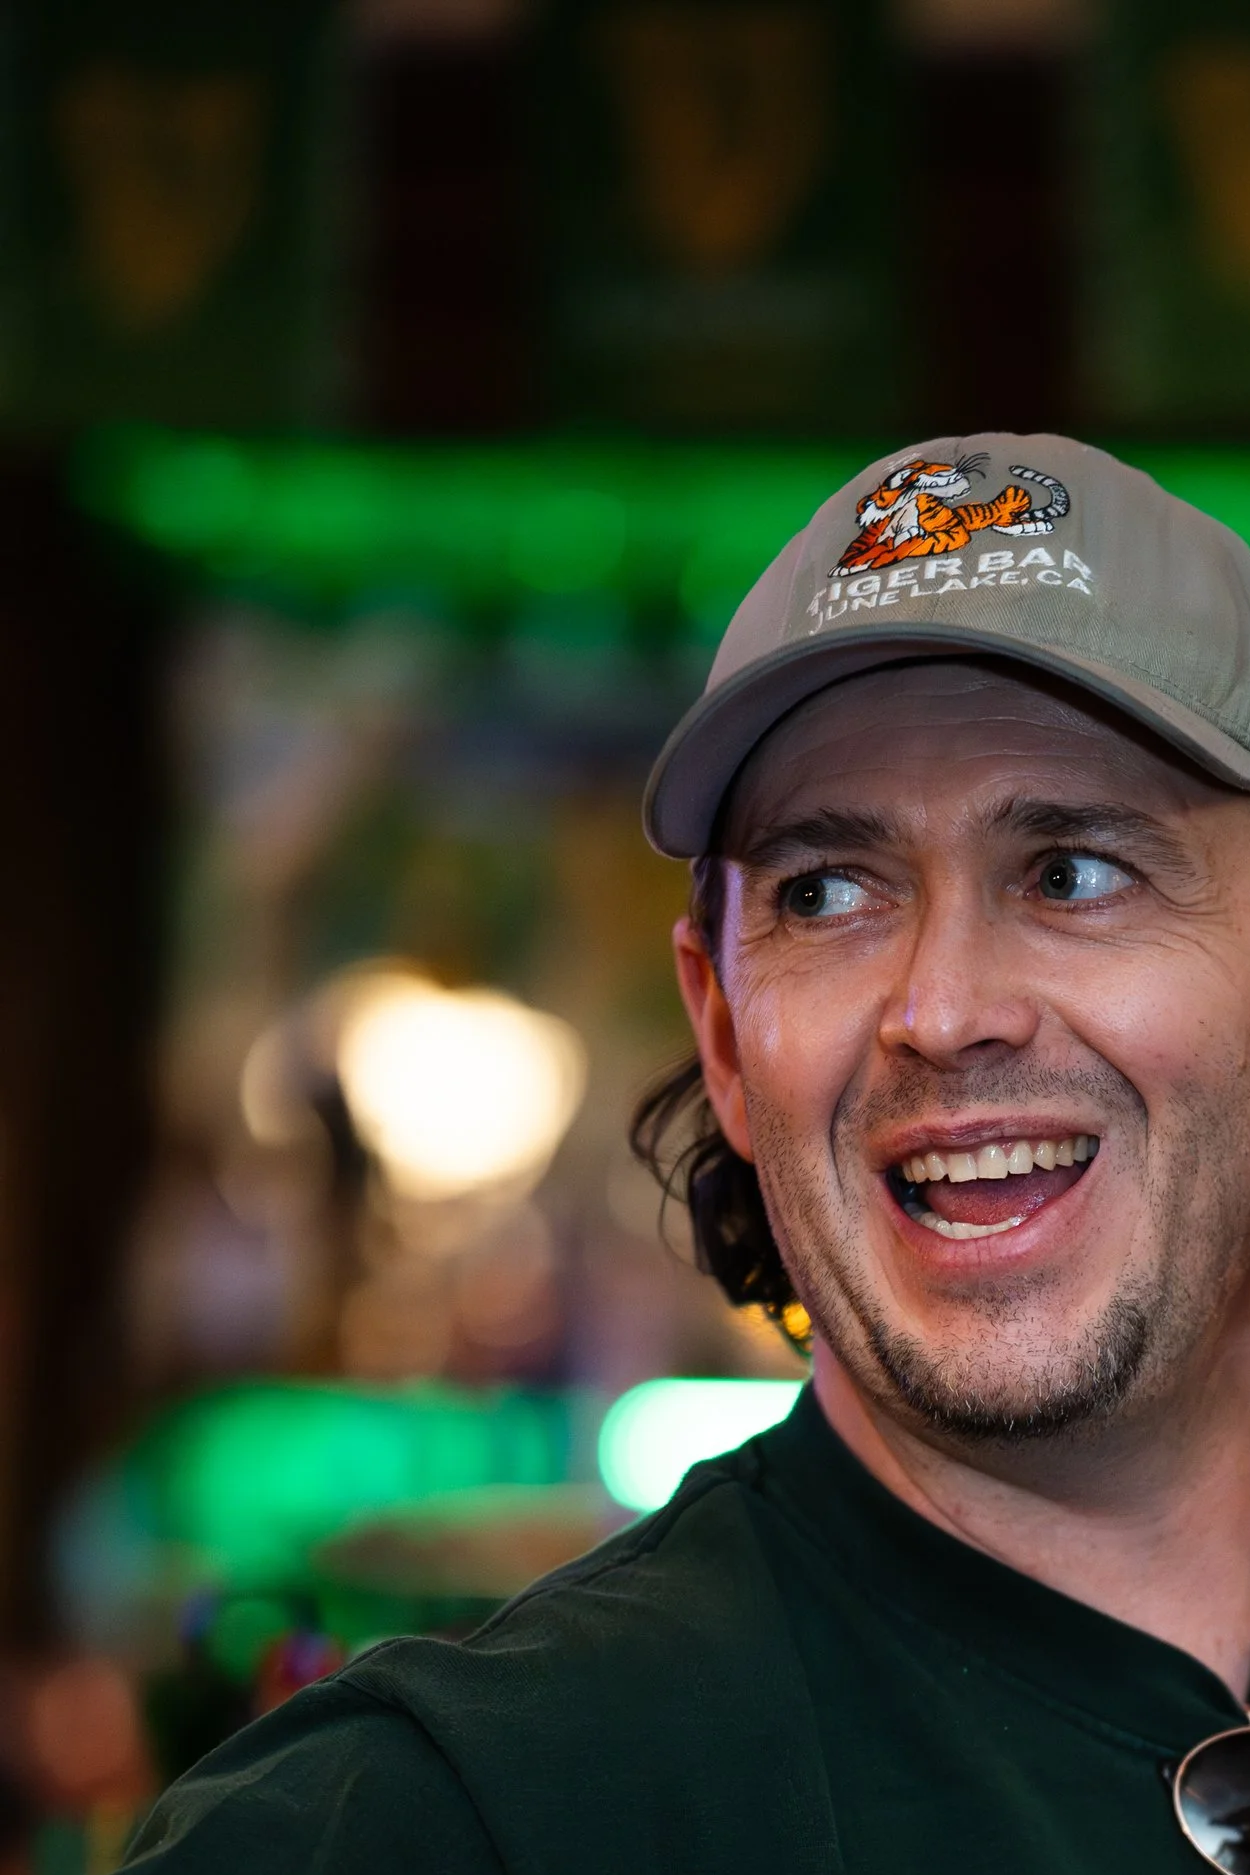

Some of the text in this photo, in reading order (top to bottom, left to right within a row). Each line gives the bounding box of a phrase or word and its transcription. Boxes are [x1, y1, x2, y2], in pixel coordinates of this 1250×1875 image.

[806, 547, 1096, 617] TIGER BAR
[807, 591, 900, 636] JUNE
[1036, 569, 1093, 596] CA
